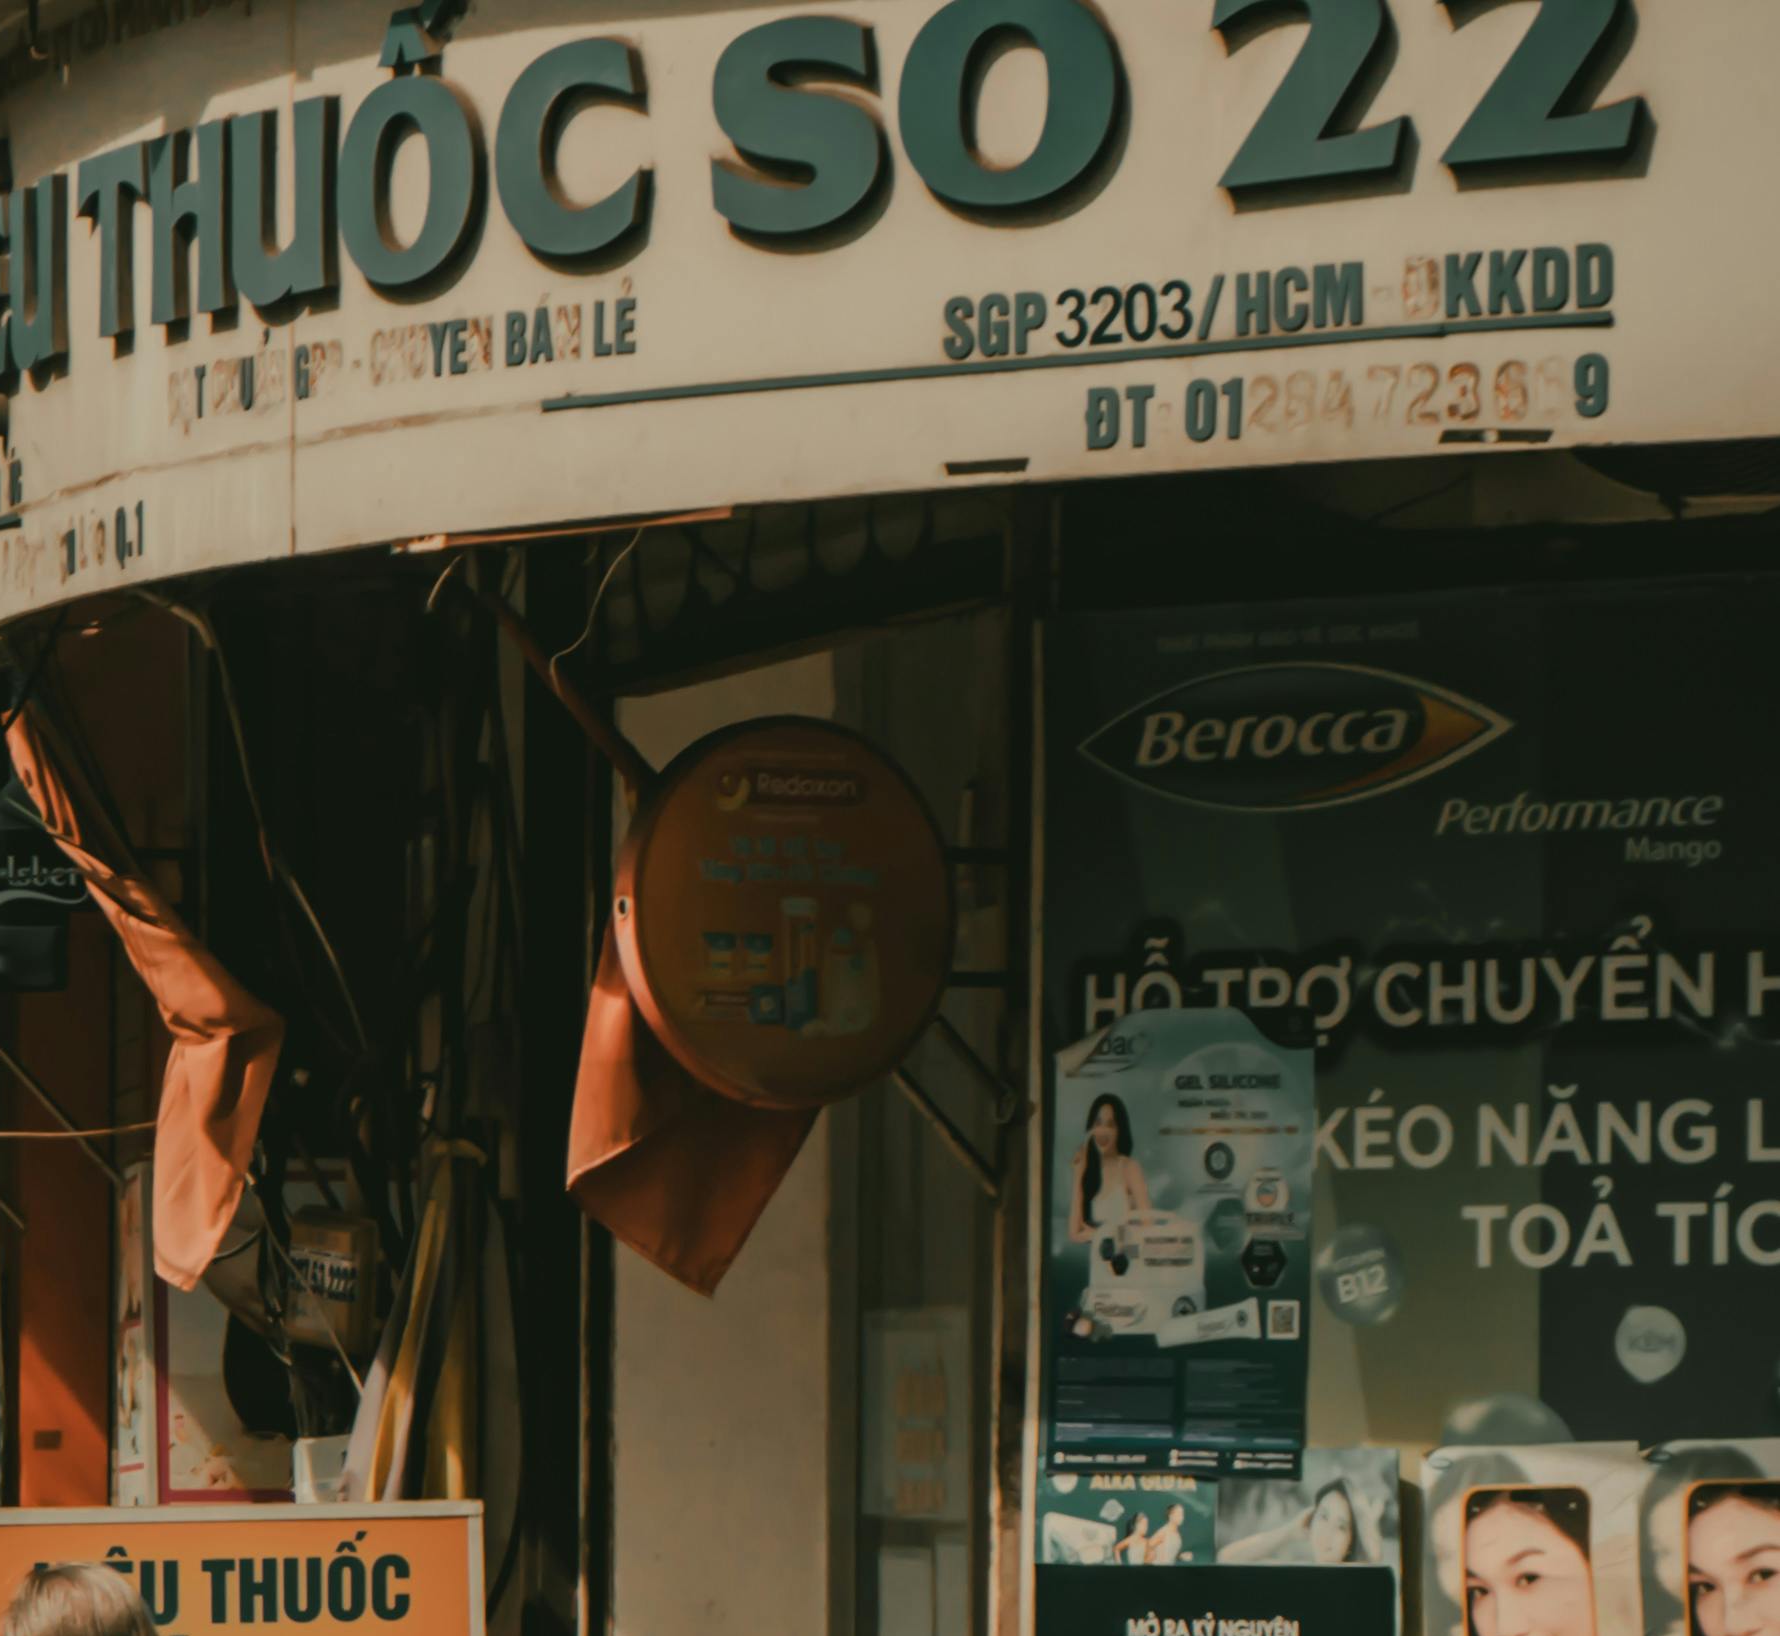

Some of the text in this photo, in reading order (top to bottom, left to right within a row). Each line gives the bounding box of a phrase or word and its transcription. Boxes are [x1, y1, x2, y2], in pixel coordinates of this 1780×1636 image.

[77, 0, 647, 340] THUỐC
[1213, 0, 1654, 205] 22
[1134, 707, 1408, 768] Berocca
[1435, 793, 1724, 837] Performance
[1626, 836, 1723, 866] Mango
[1373, 914, 1715, 1028] CHUYỂN
[1478, 1083, 1717, 1167] NĂNG
[1460, 1175, 1652, 1269] TOẢ
[1337, 1268, 1389, 1303] B12
[202, 1529, 412, 1625] THUỐC
